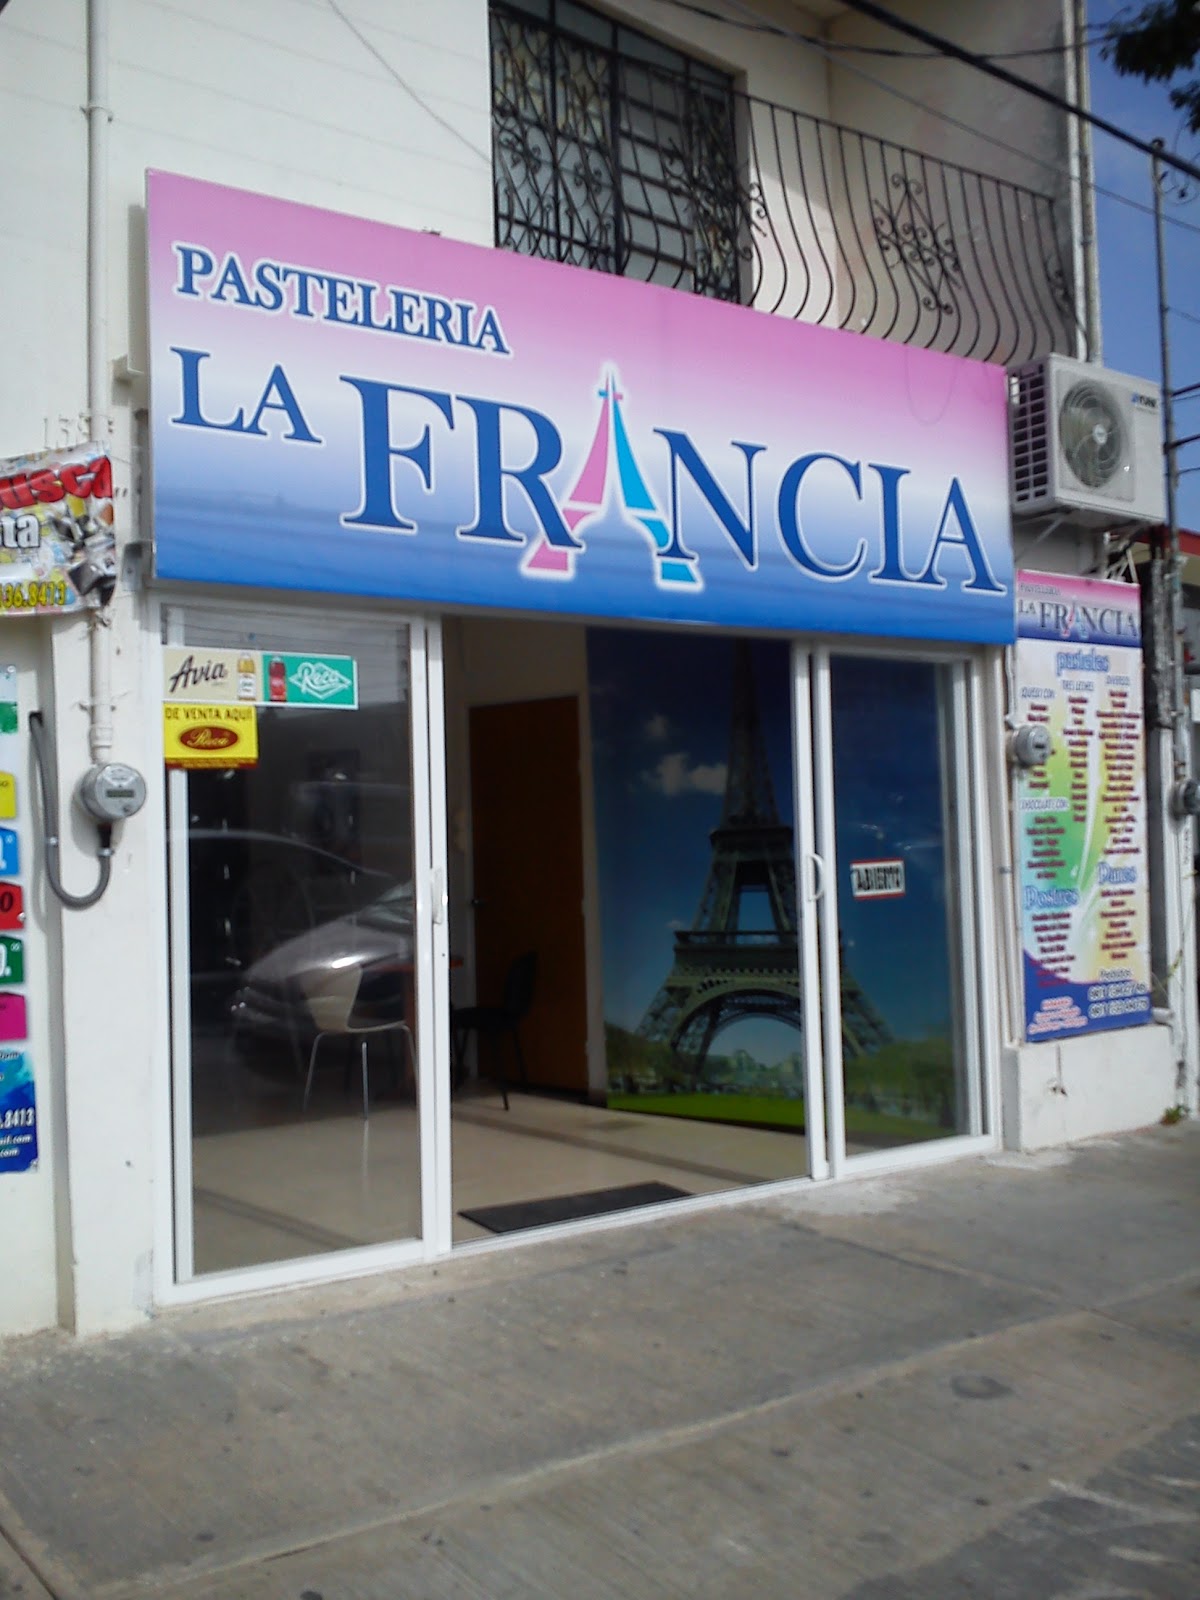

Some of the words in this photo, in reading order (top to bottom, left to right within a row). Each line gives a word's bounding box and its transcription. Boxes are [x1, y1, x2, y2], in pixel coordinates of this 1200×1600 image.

[174, 244, 511, 356] PASTELERIA
[169, 345, 323, 445] LA
[339, 366, 1007, 595] FRANCIA
[0, 514, 40, 549] ta
[0, 580, 66, 608] 36.8413
[168, 655, 225, 693] Avia
[183, 707, 222, 720] VENTA
